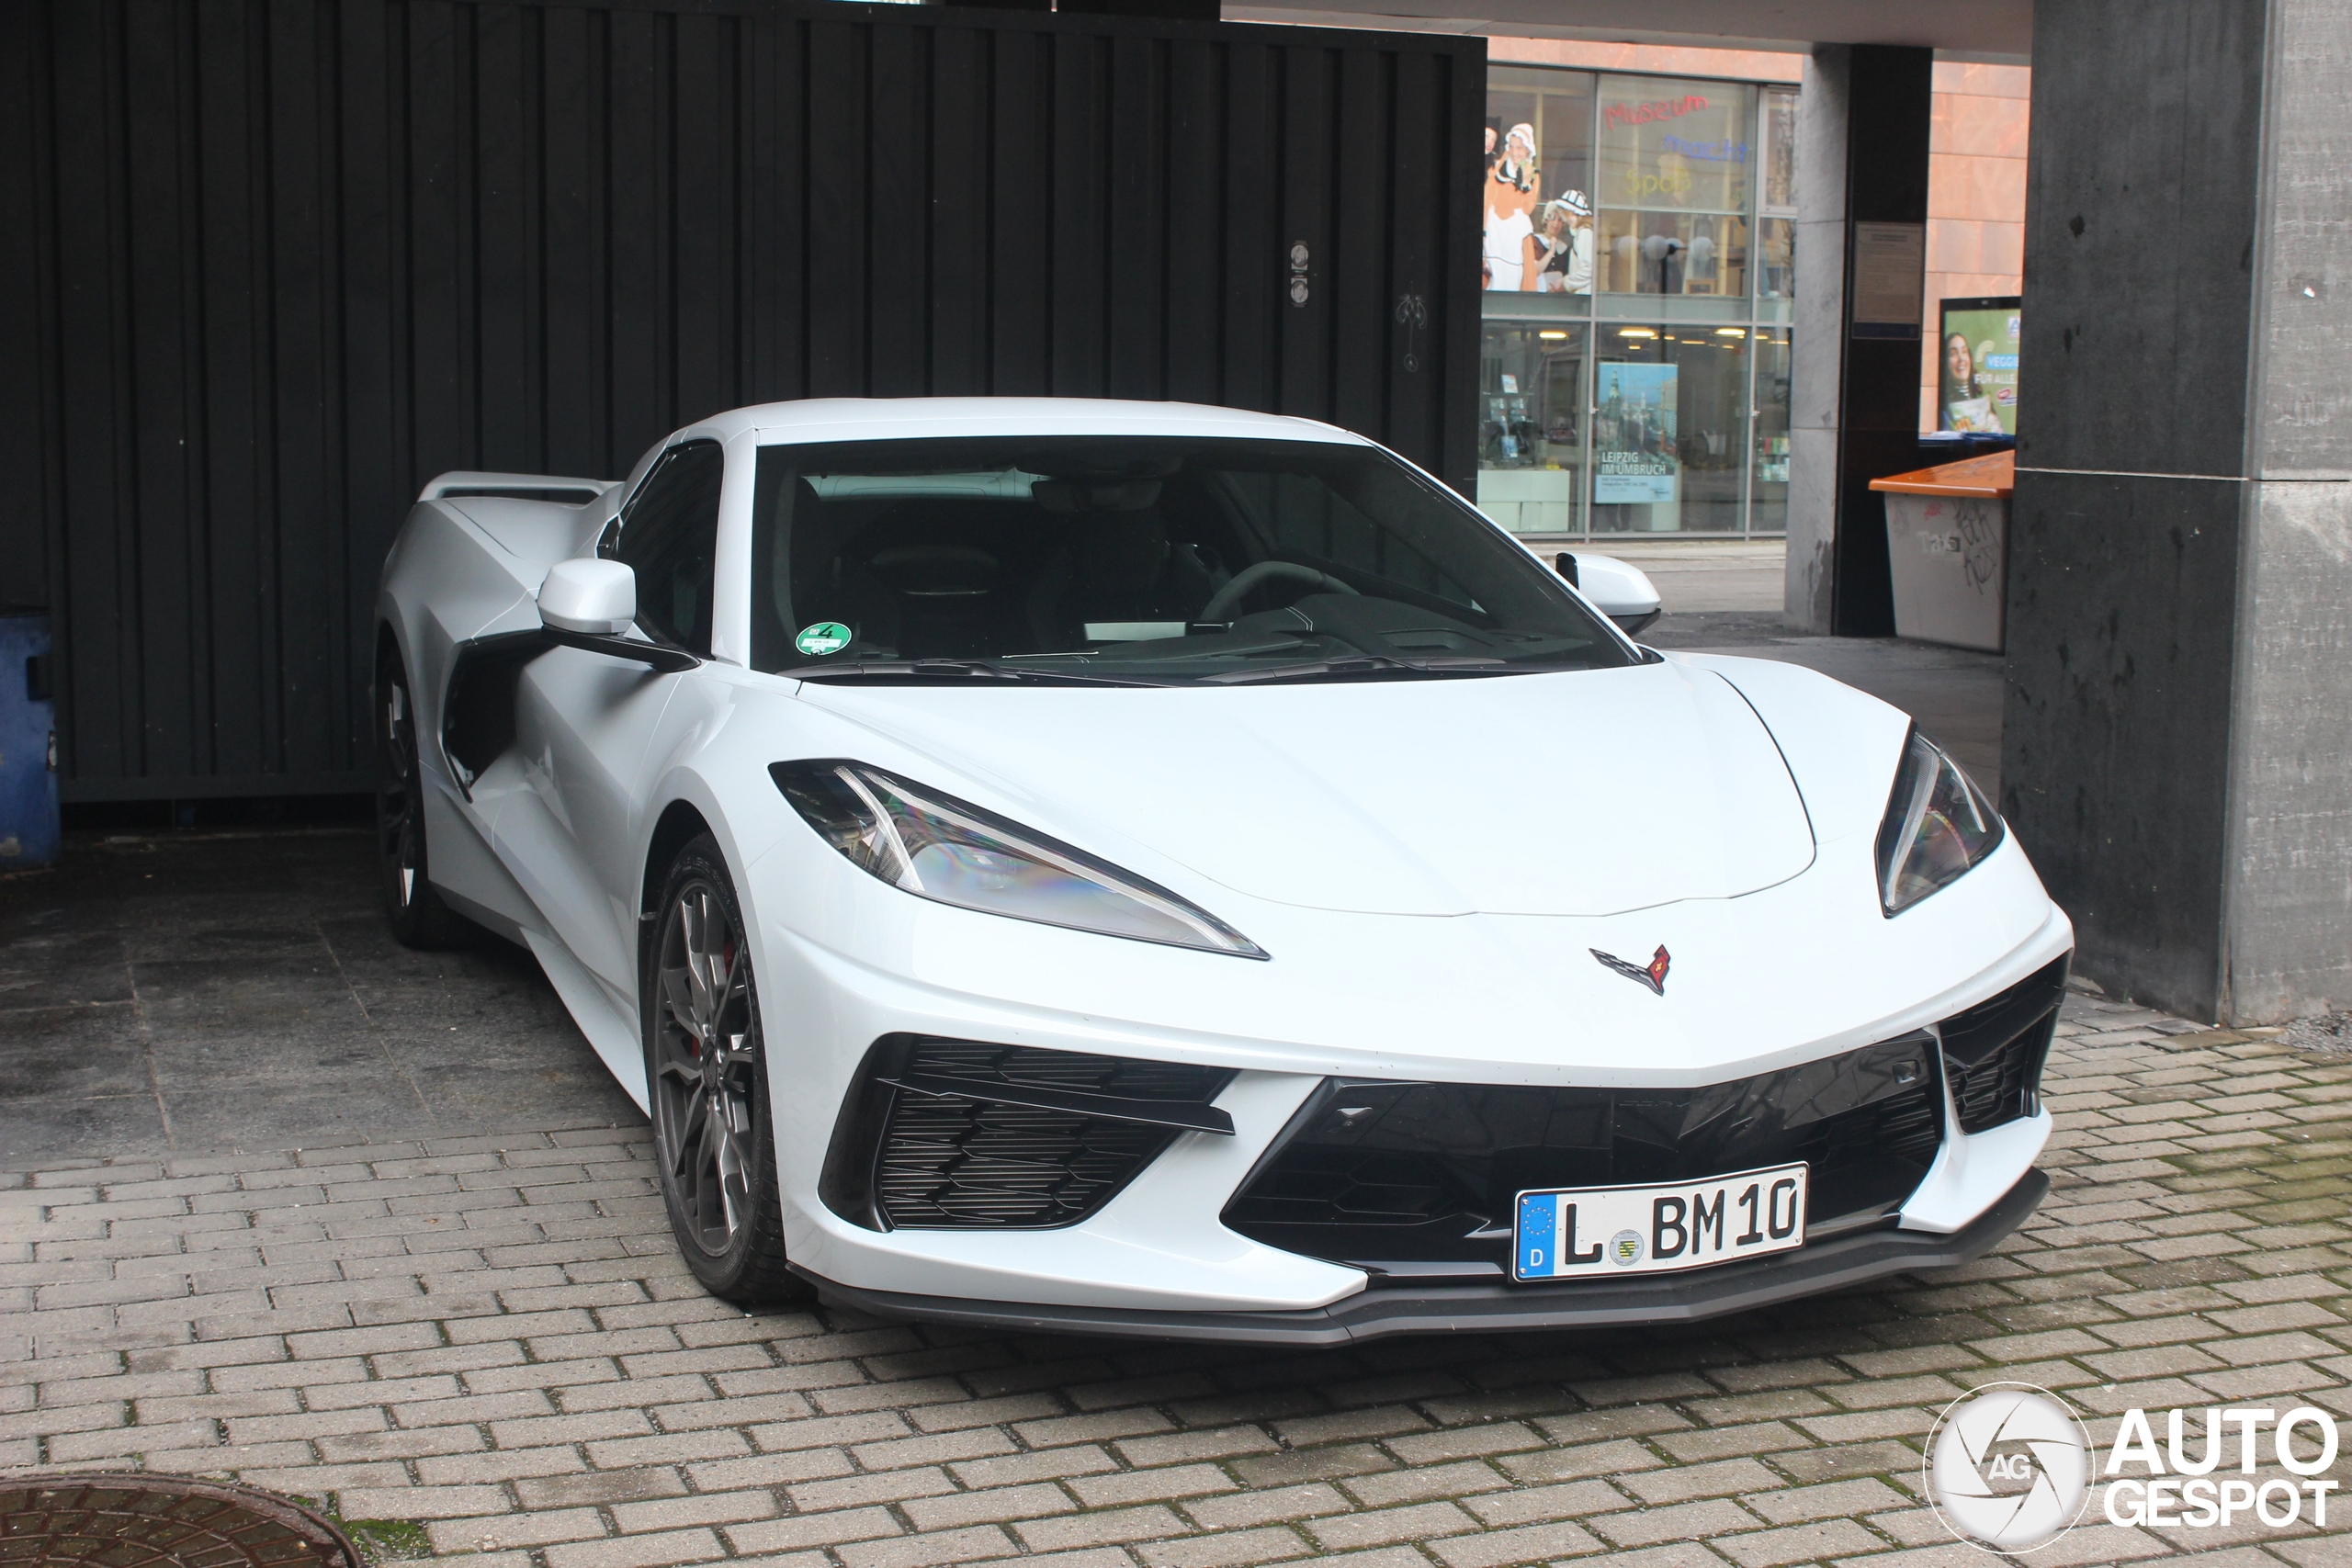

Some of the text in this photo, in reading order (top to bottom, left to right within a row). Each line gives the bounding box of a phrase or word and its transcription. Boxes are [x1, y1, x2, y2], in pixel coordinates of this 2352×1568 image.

[1605, 95, 1709, 130] Museum
[1663, 135, 1747, 164] macht
[1973, 371, 2017, 384] FÜR ALLE
[1601, 452, 1639, 463] LEIPZIG
[1601, 464, 1667, 475] IM UMBRUCH
[818, 625, 833, 638] 4
[1530, 1178, 1798, 1268] D L BM 10
